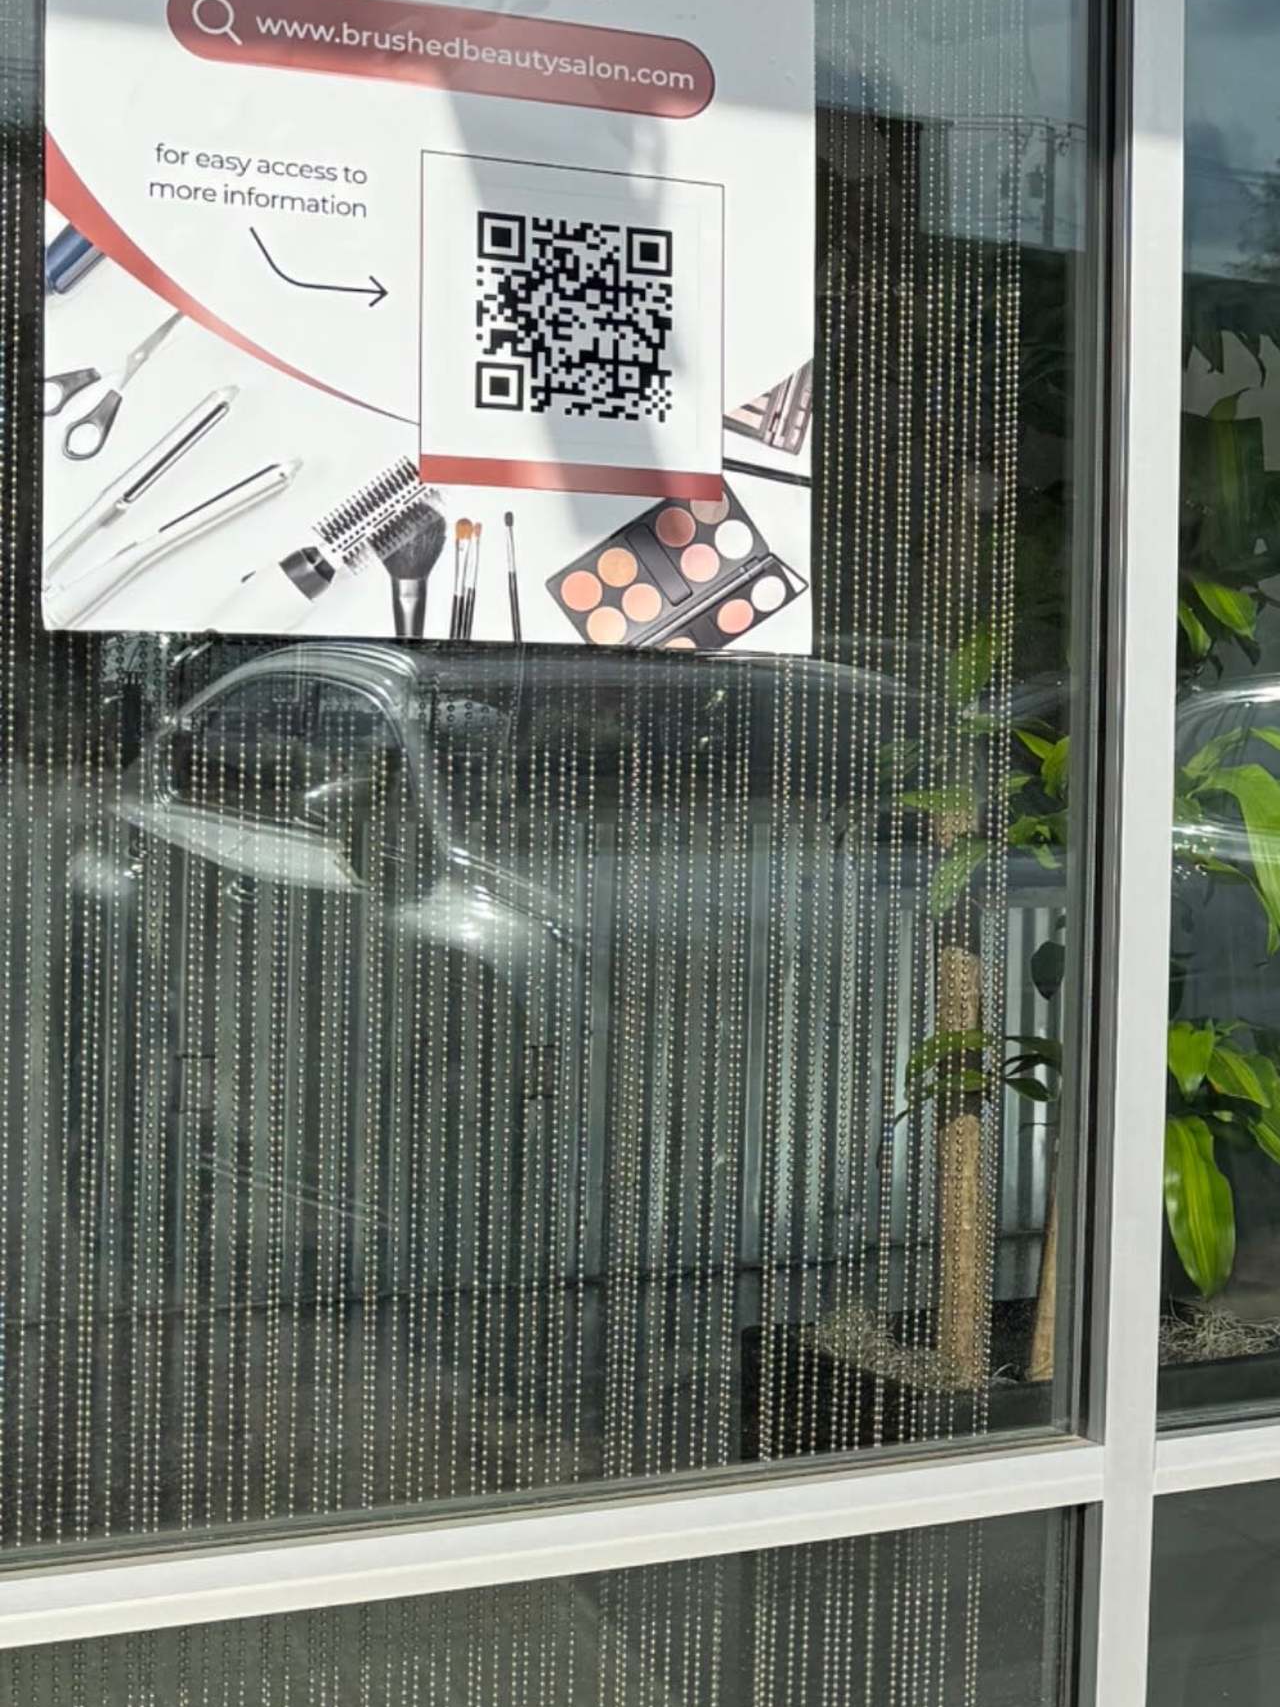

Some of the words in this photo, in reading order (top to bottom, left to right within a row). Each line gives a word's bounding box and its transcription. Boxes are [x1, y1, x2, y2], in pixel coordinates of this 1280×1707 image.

[255, 15, 695, 92] www.brushedbeautysalon.com
[154, 142, 189, 166] for
[195, 151, 251, 177] easy
[256, 156, 337, 181] access
[343, 163, 368, 185] to
[148, 181, 217, 204] more
[222, 187, 368, 218] information
